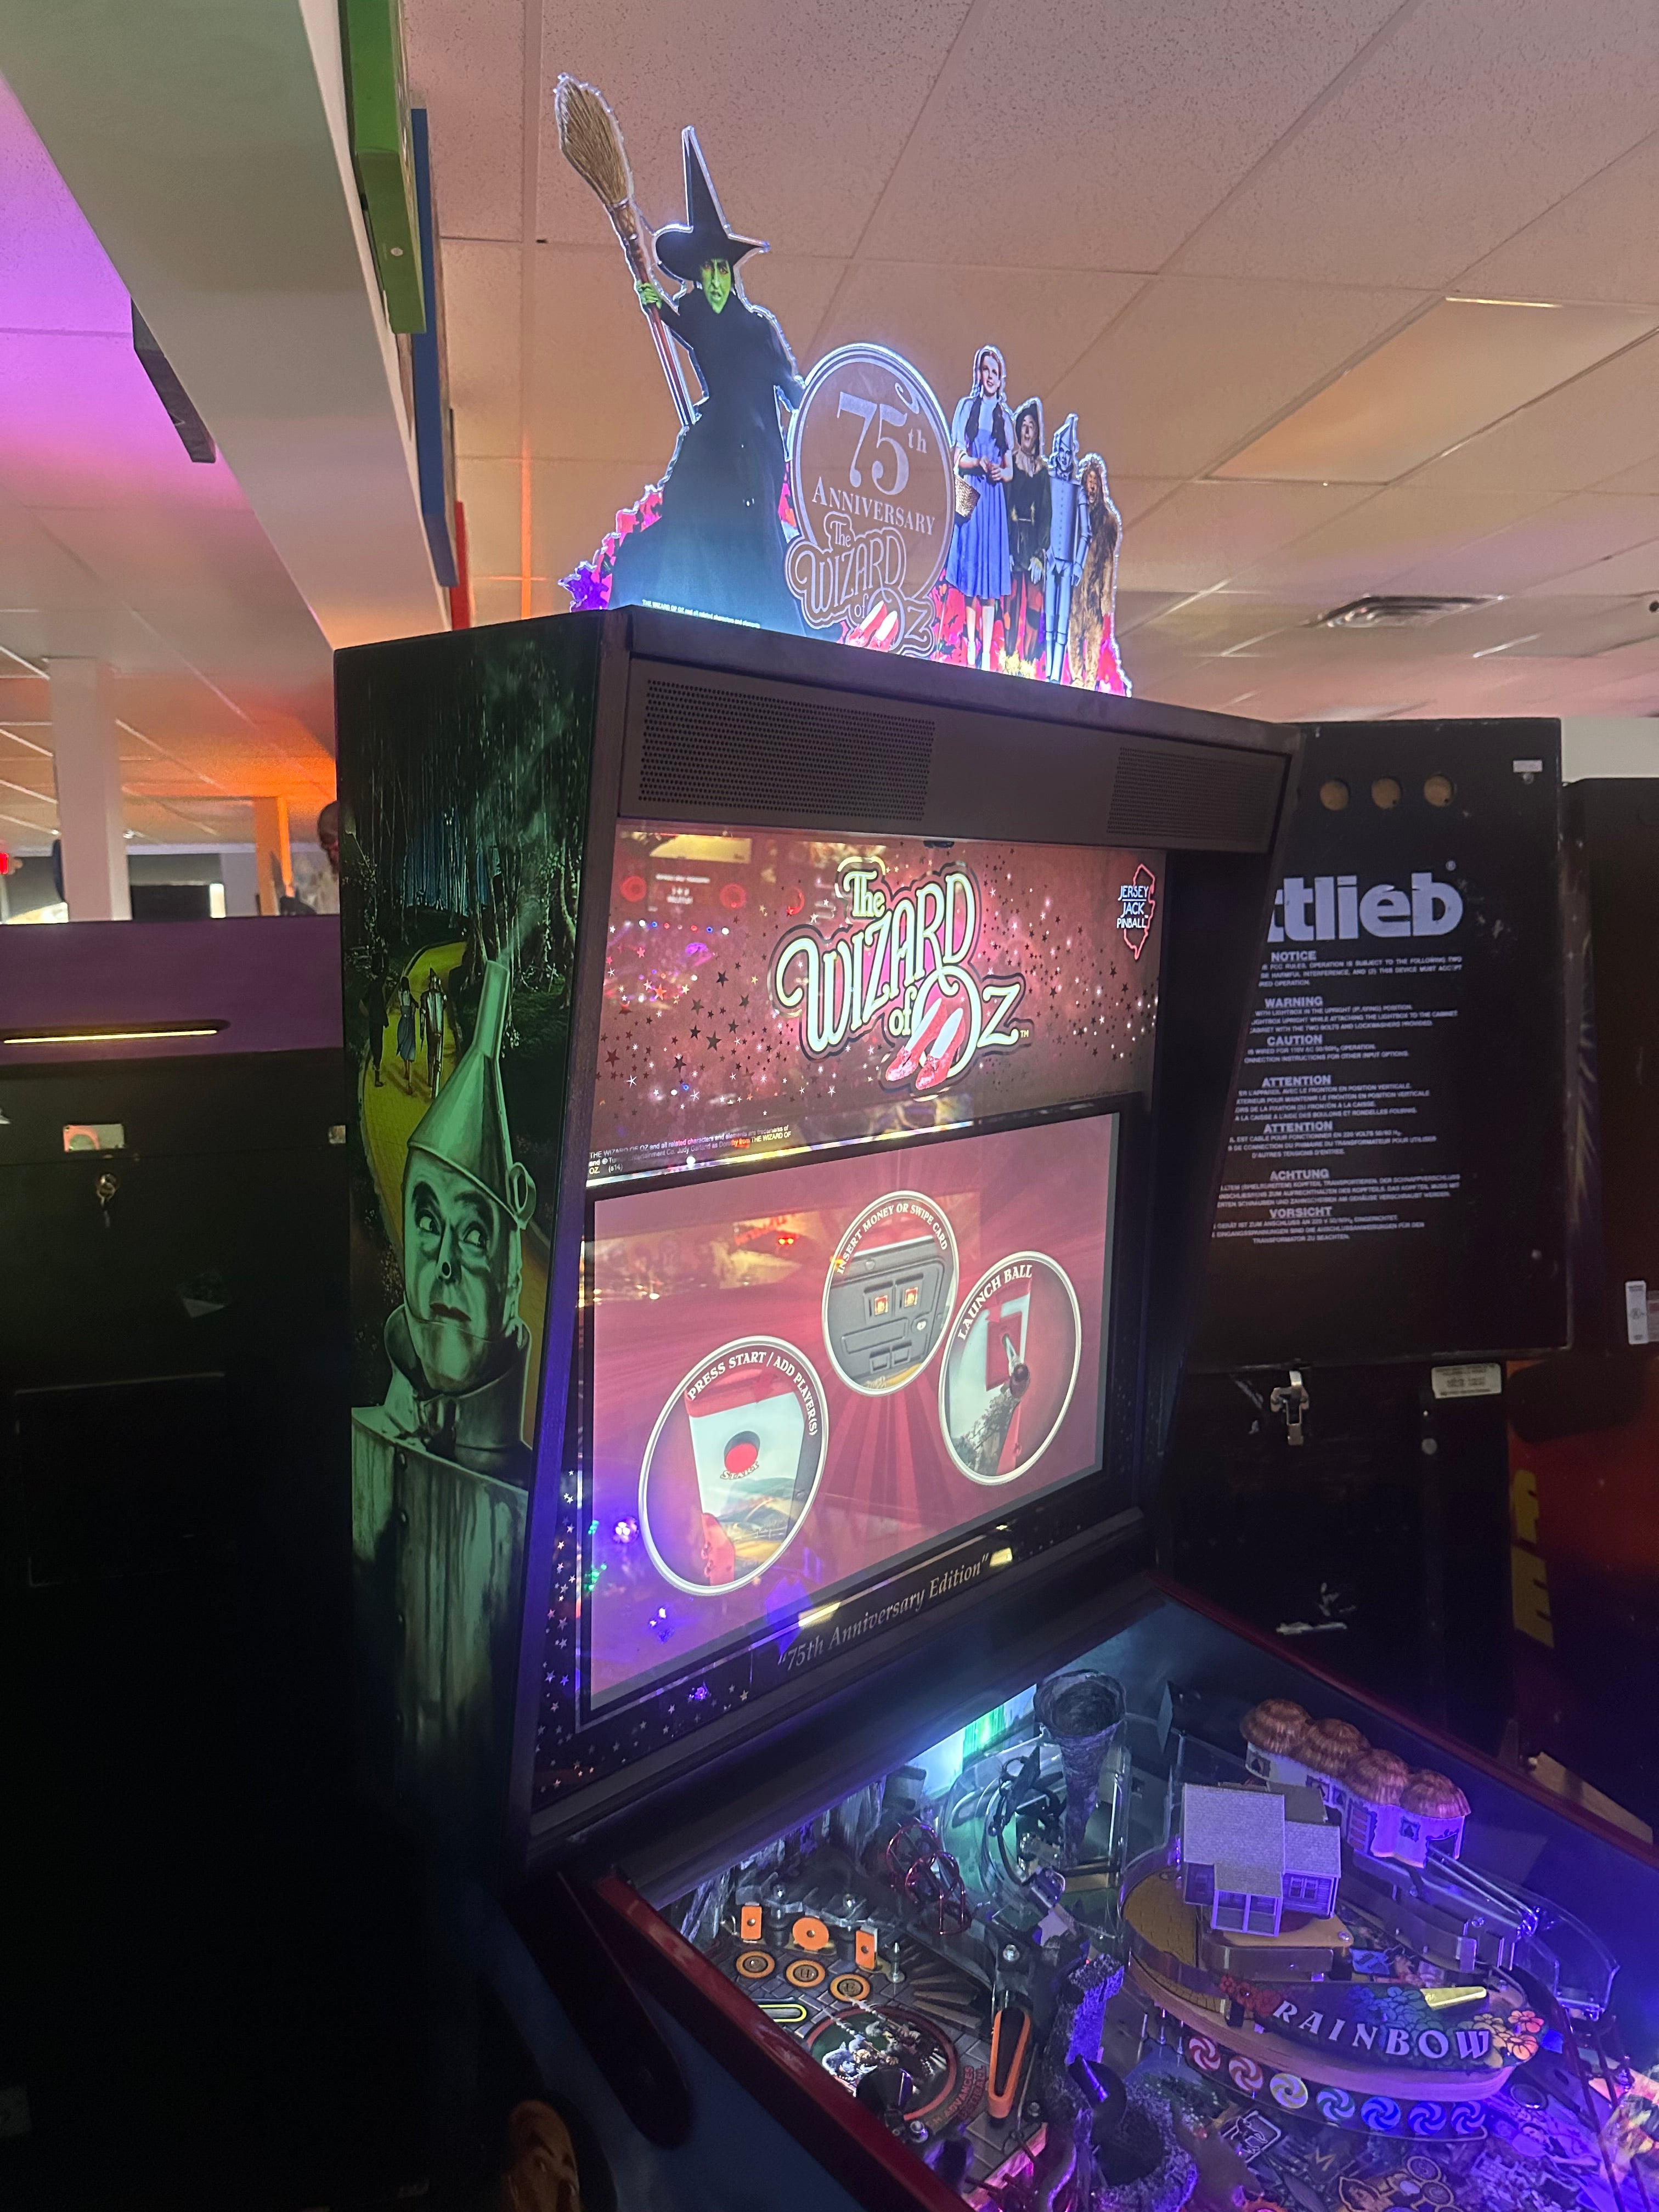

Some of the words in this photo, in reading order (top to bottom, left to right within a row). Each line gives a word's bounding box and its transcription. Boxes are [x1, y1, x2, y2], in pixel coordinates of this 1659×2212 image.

[812, 476, 935, 535] ANNIVERSARY
[831, 520, 851, 548] The
[795, 535, 902, 614] WIZARD
[854, 593, 869, 618] of
[844, 871, 885, 918] The
[1118, 885, 1149, 901] JERSEY
[1120, 902, 1144, 918] JACK
[1116, 918, 1147, 928] PINBALL
[776, 873, 975, 1052] WIZARD
[1271, 951, 1317, 962] NOTICE
[889, 985, 916, 1036] of
[1265, 996, 1323, 1008] WARNING
[1267, 1034, 1323, 1046] CAUTION
[1262, 1075, 1331, 1087] ATTENTION
[763, 1133, 783, 1141] WIZARD
[1263, 1121, 1333, 1134] ATTENTION
[668, 1138, 687, 1147] related
[687, 1136, 714, 1145] characters
[1269, 1169, 1329, 1181] ACHTUNG
[1269, 1206, 1332, 1218] VORSICHT
[837, 1228, 863, 1275] INSERT
[862, 1204, 894, 1232] MONEY
[896, 1203, 909, 1214] OR
[910, 1204, 934, 1225] SWIPE
[933, 1222, 948, 1251] CARD
[957, 1276, 1002, 1341] LAUNCH
[1003, 1264, 1032, 1282] BALL
[687, 1363, 726, 1402] PRESS
[729, 1351, 766, 1370] START
[774, 1358, 795, 1377] ADD
[794, 1373, 818, 1436] PLAYER(S)
[720, 1460, 760, 1481] START
[828, 1588, 925, 1650] Anniversary
[1273, 2000, 1489, 2059] RAINBOW
